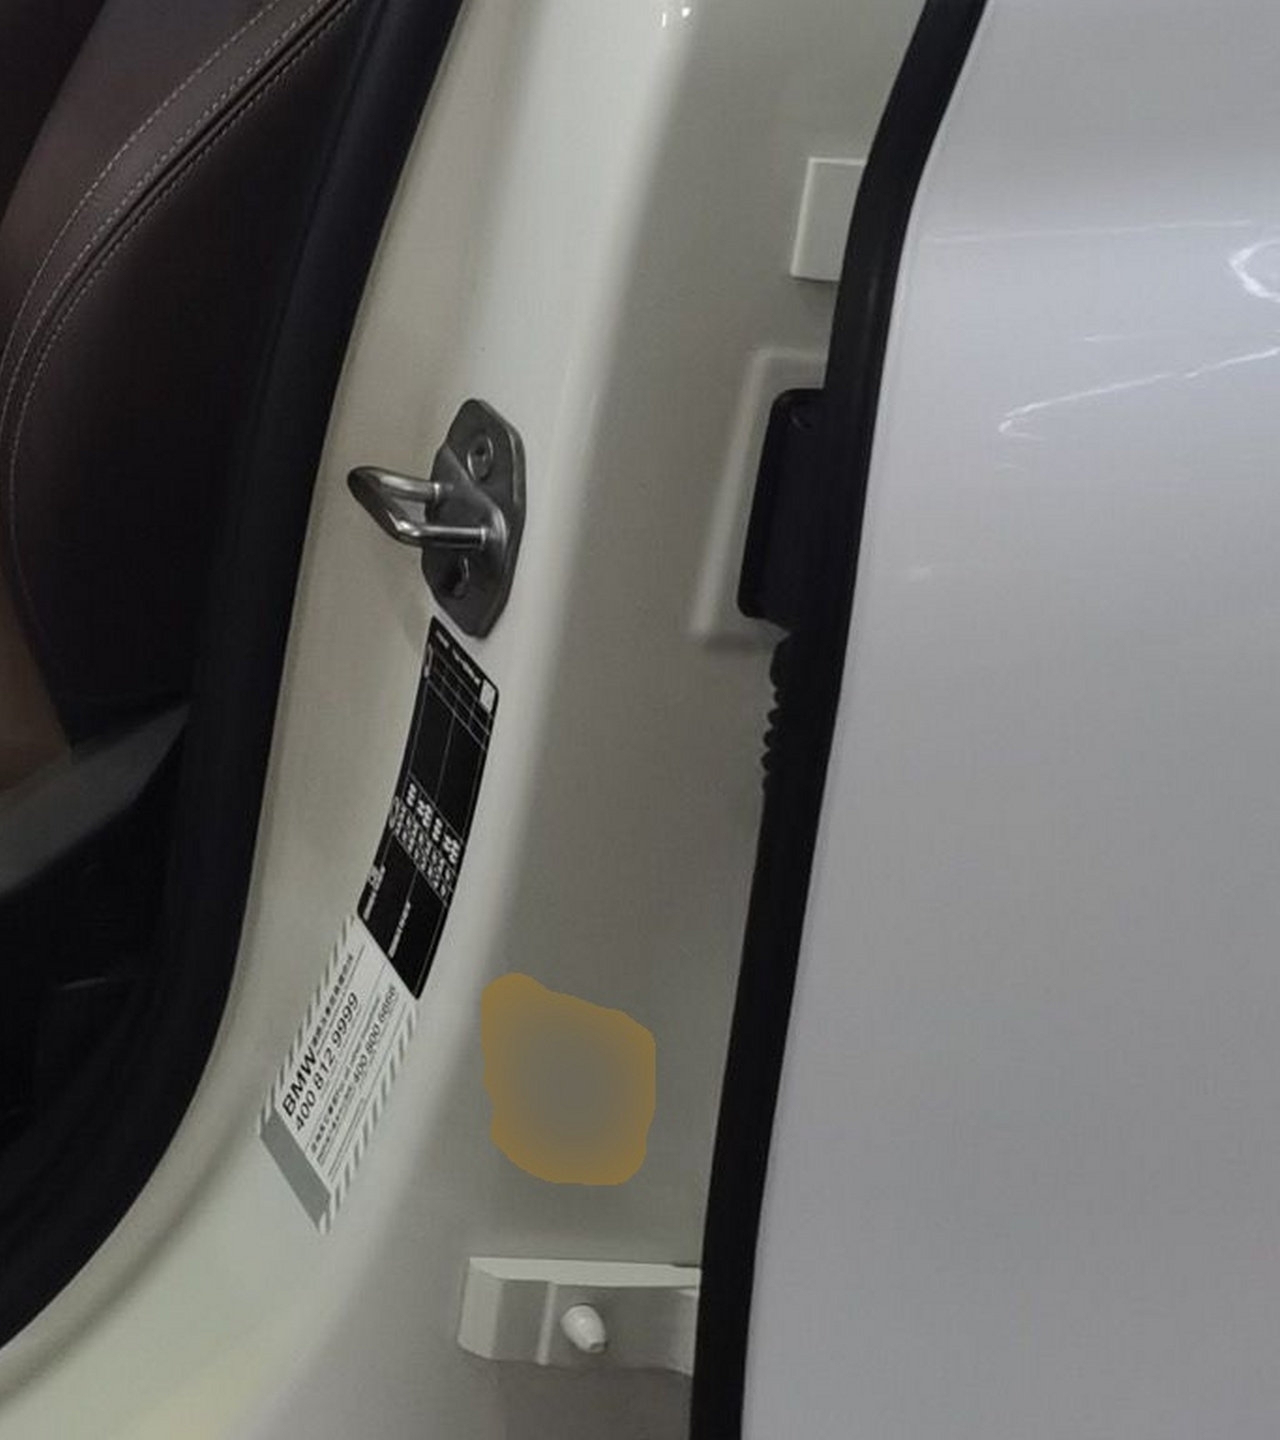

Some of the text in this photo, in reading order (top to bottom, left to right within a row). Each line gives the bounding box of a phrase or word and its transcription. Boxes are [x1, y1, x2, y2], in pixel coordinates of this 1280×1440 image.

[282, 1046, 317, 1117] BMW
[295, 1089, 317, 1131] 400
[313, 1048, 335, 1090] 812
[332, 992, 359, 1046] 9999
